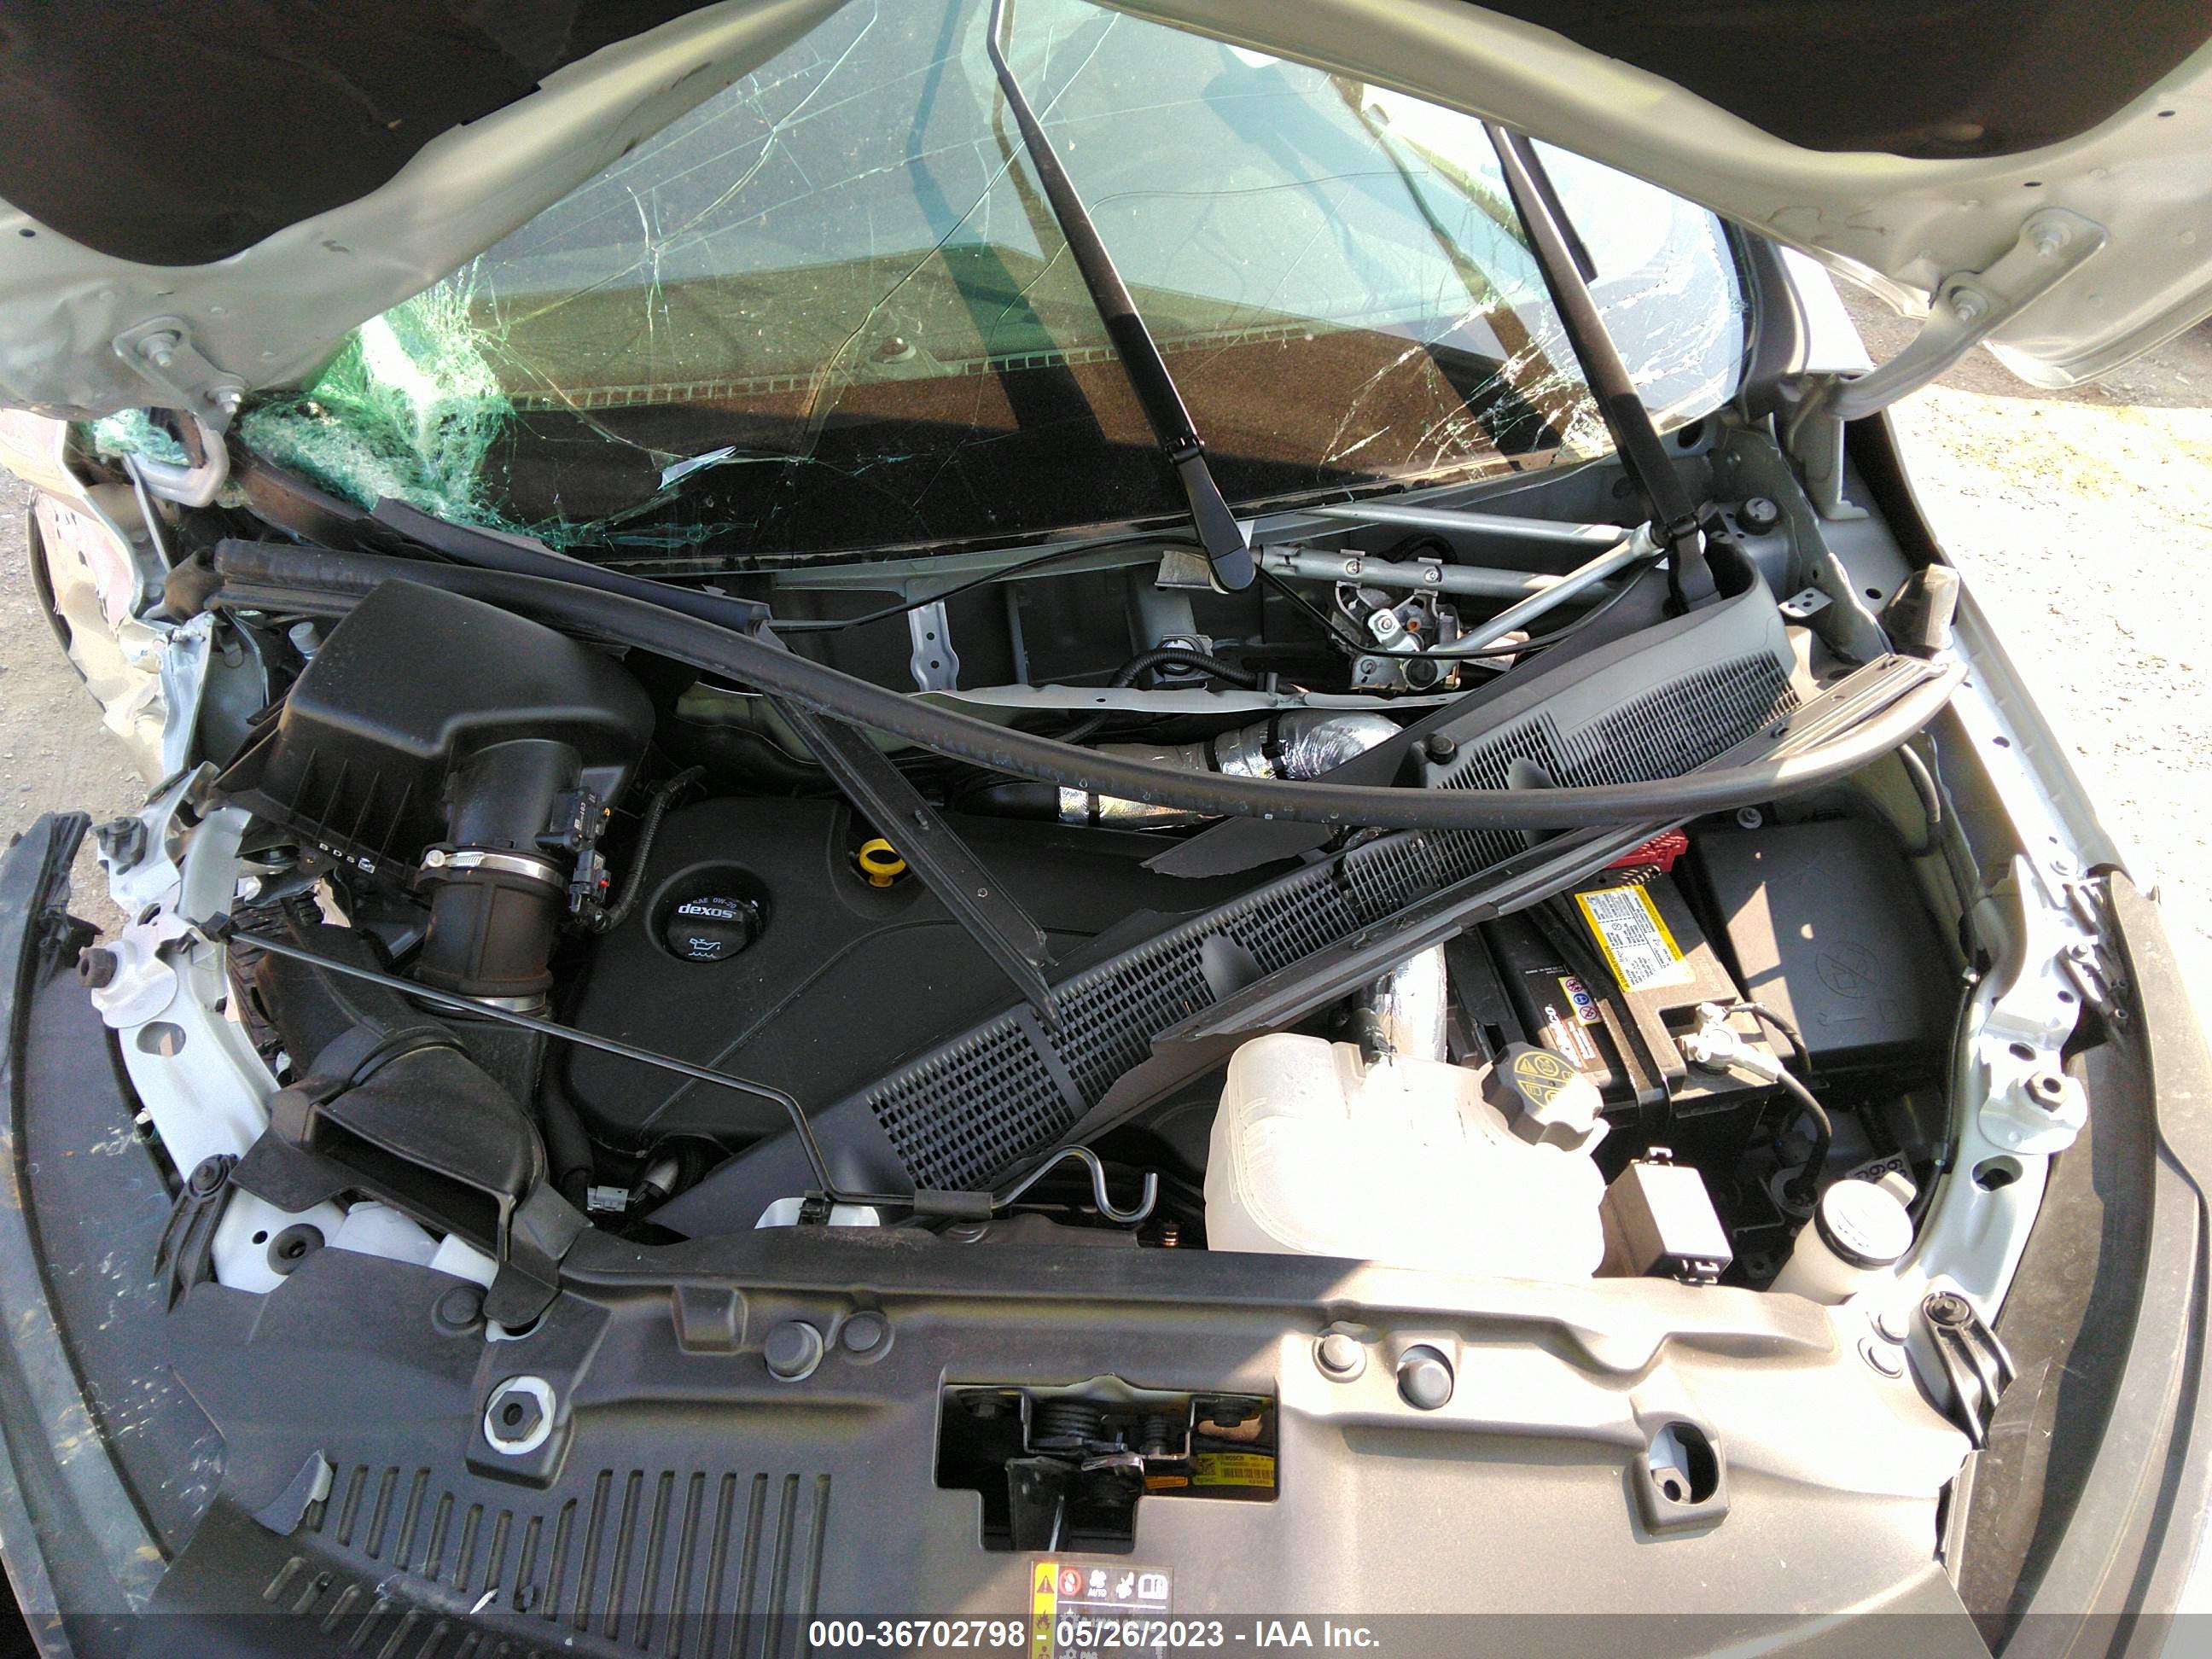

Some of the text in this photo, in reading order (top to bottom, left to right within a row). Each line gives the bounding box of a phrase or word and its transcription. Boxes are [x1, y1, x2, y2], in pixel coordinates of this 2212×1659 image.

[713, 898, 736, 909] 0W-20
[678, 903, 733, 918] dexos
[1087, 1587, 1107, 1598] AUTO
